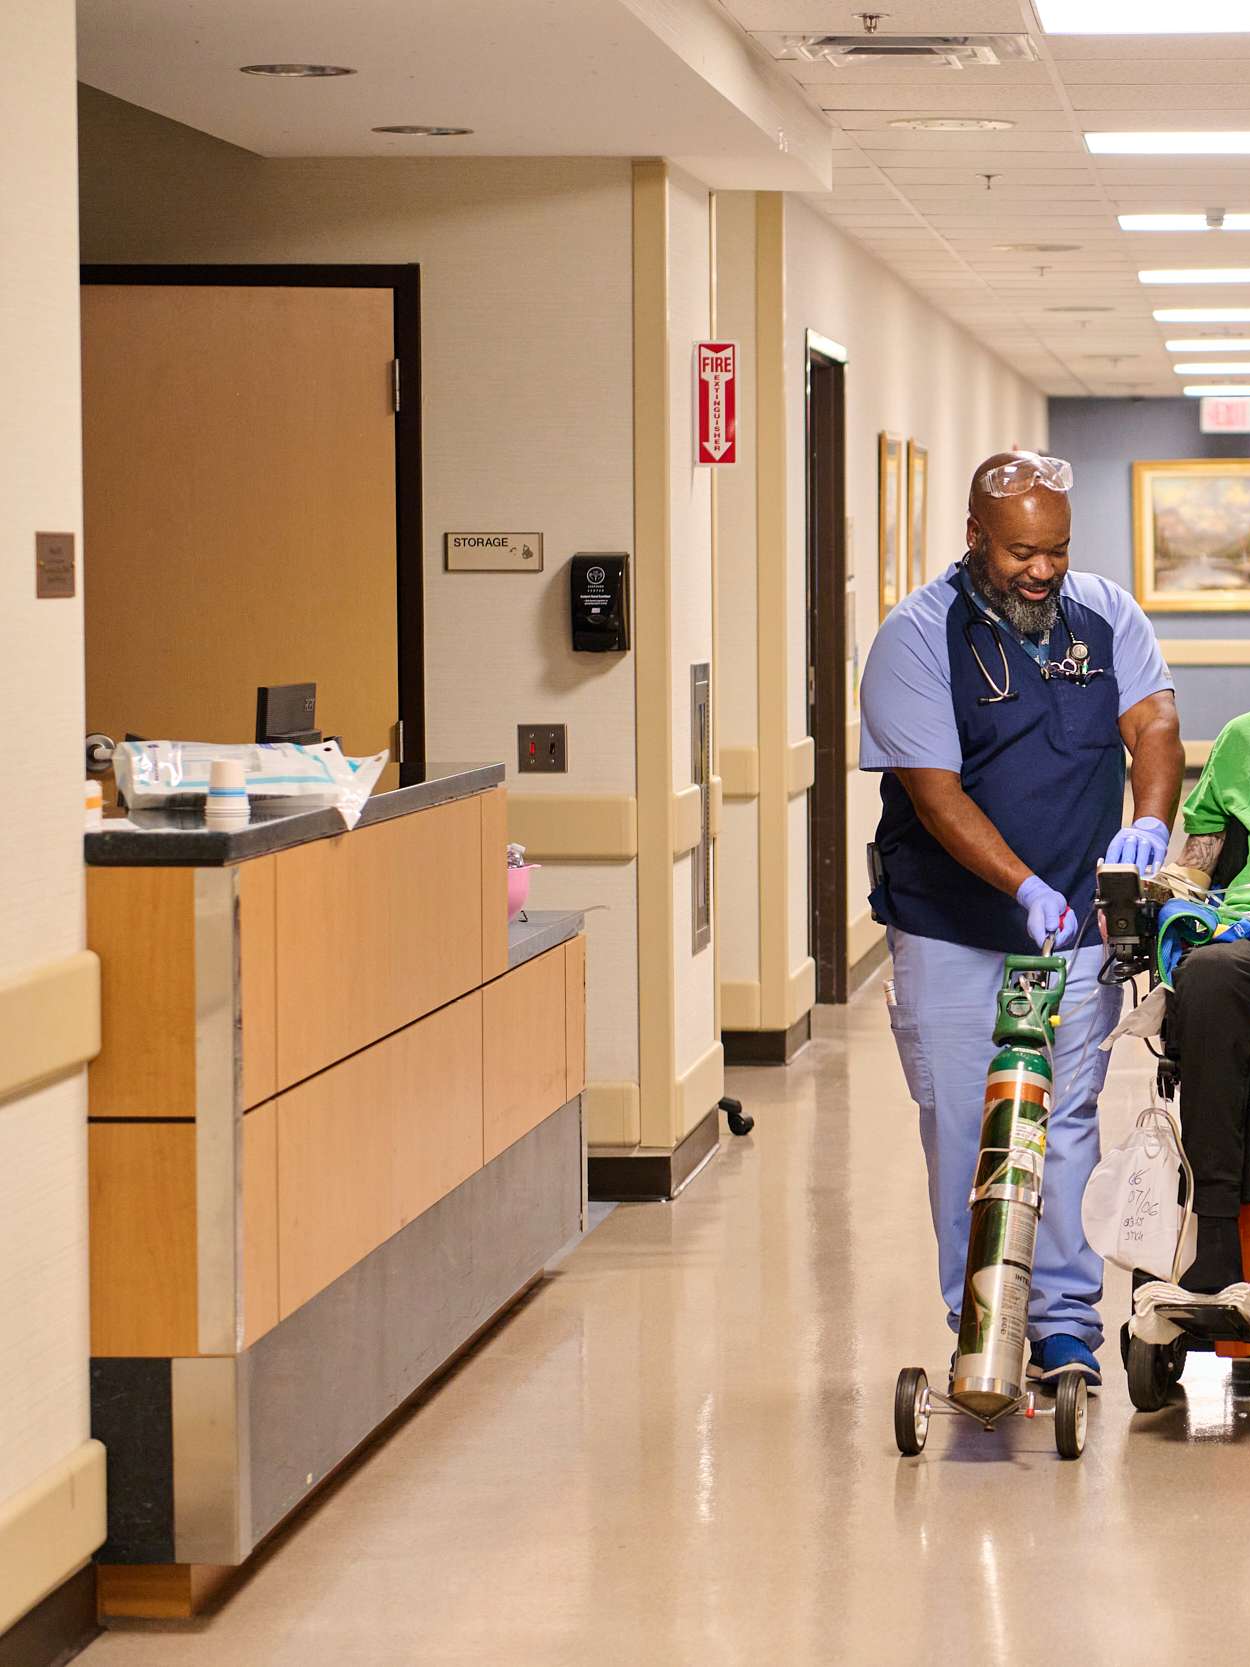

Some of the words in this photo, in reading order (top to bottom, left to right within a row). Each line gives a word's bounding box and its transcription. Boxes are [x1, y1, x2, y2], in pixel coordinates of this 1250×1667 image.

[702, 357, 732, 372] FIRE
[713, 374, 721, 451] EXTINGUISHER
[453, 537, 509, 547] STORAGE
